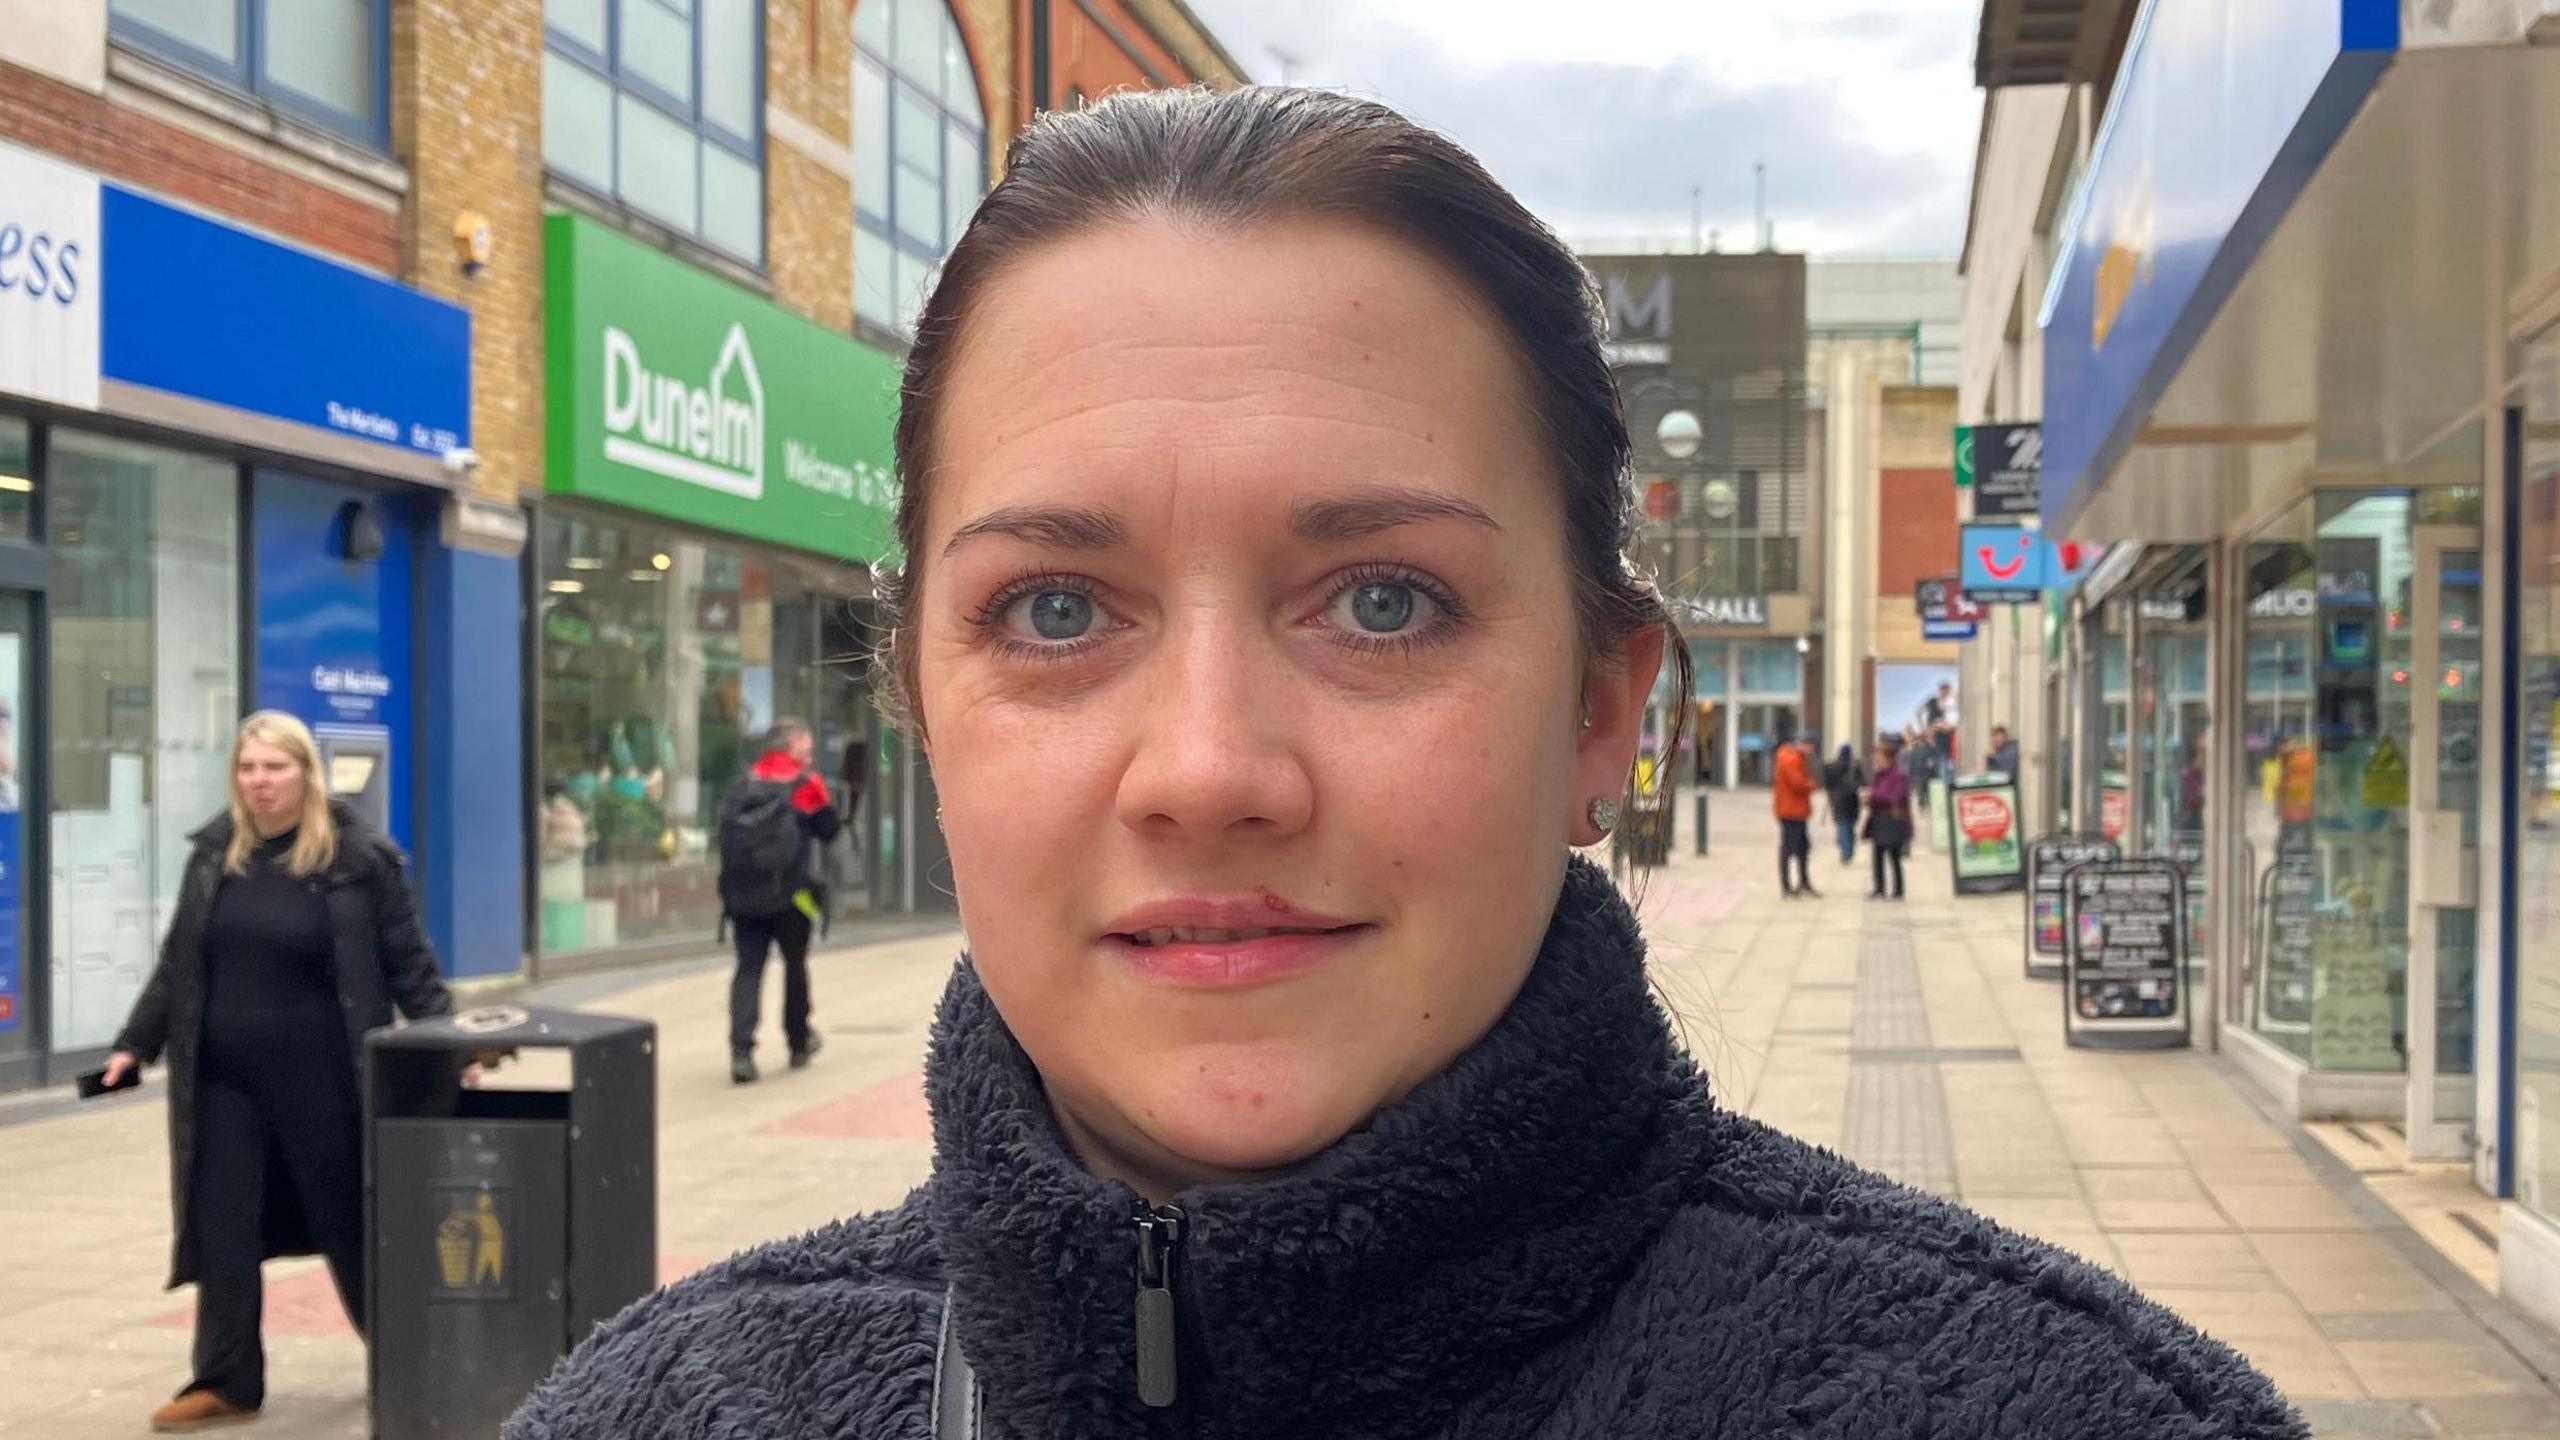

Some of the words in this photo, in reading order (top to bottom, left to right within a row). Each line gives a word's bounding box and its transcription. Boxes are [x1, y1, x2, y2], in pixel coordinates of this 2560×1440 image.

[603, 322, 762, 474] Dunelm
[782, 438, 853, 500] Welcome
[853, 460, 873, 506] To
